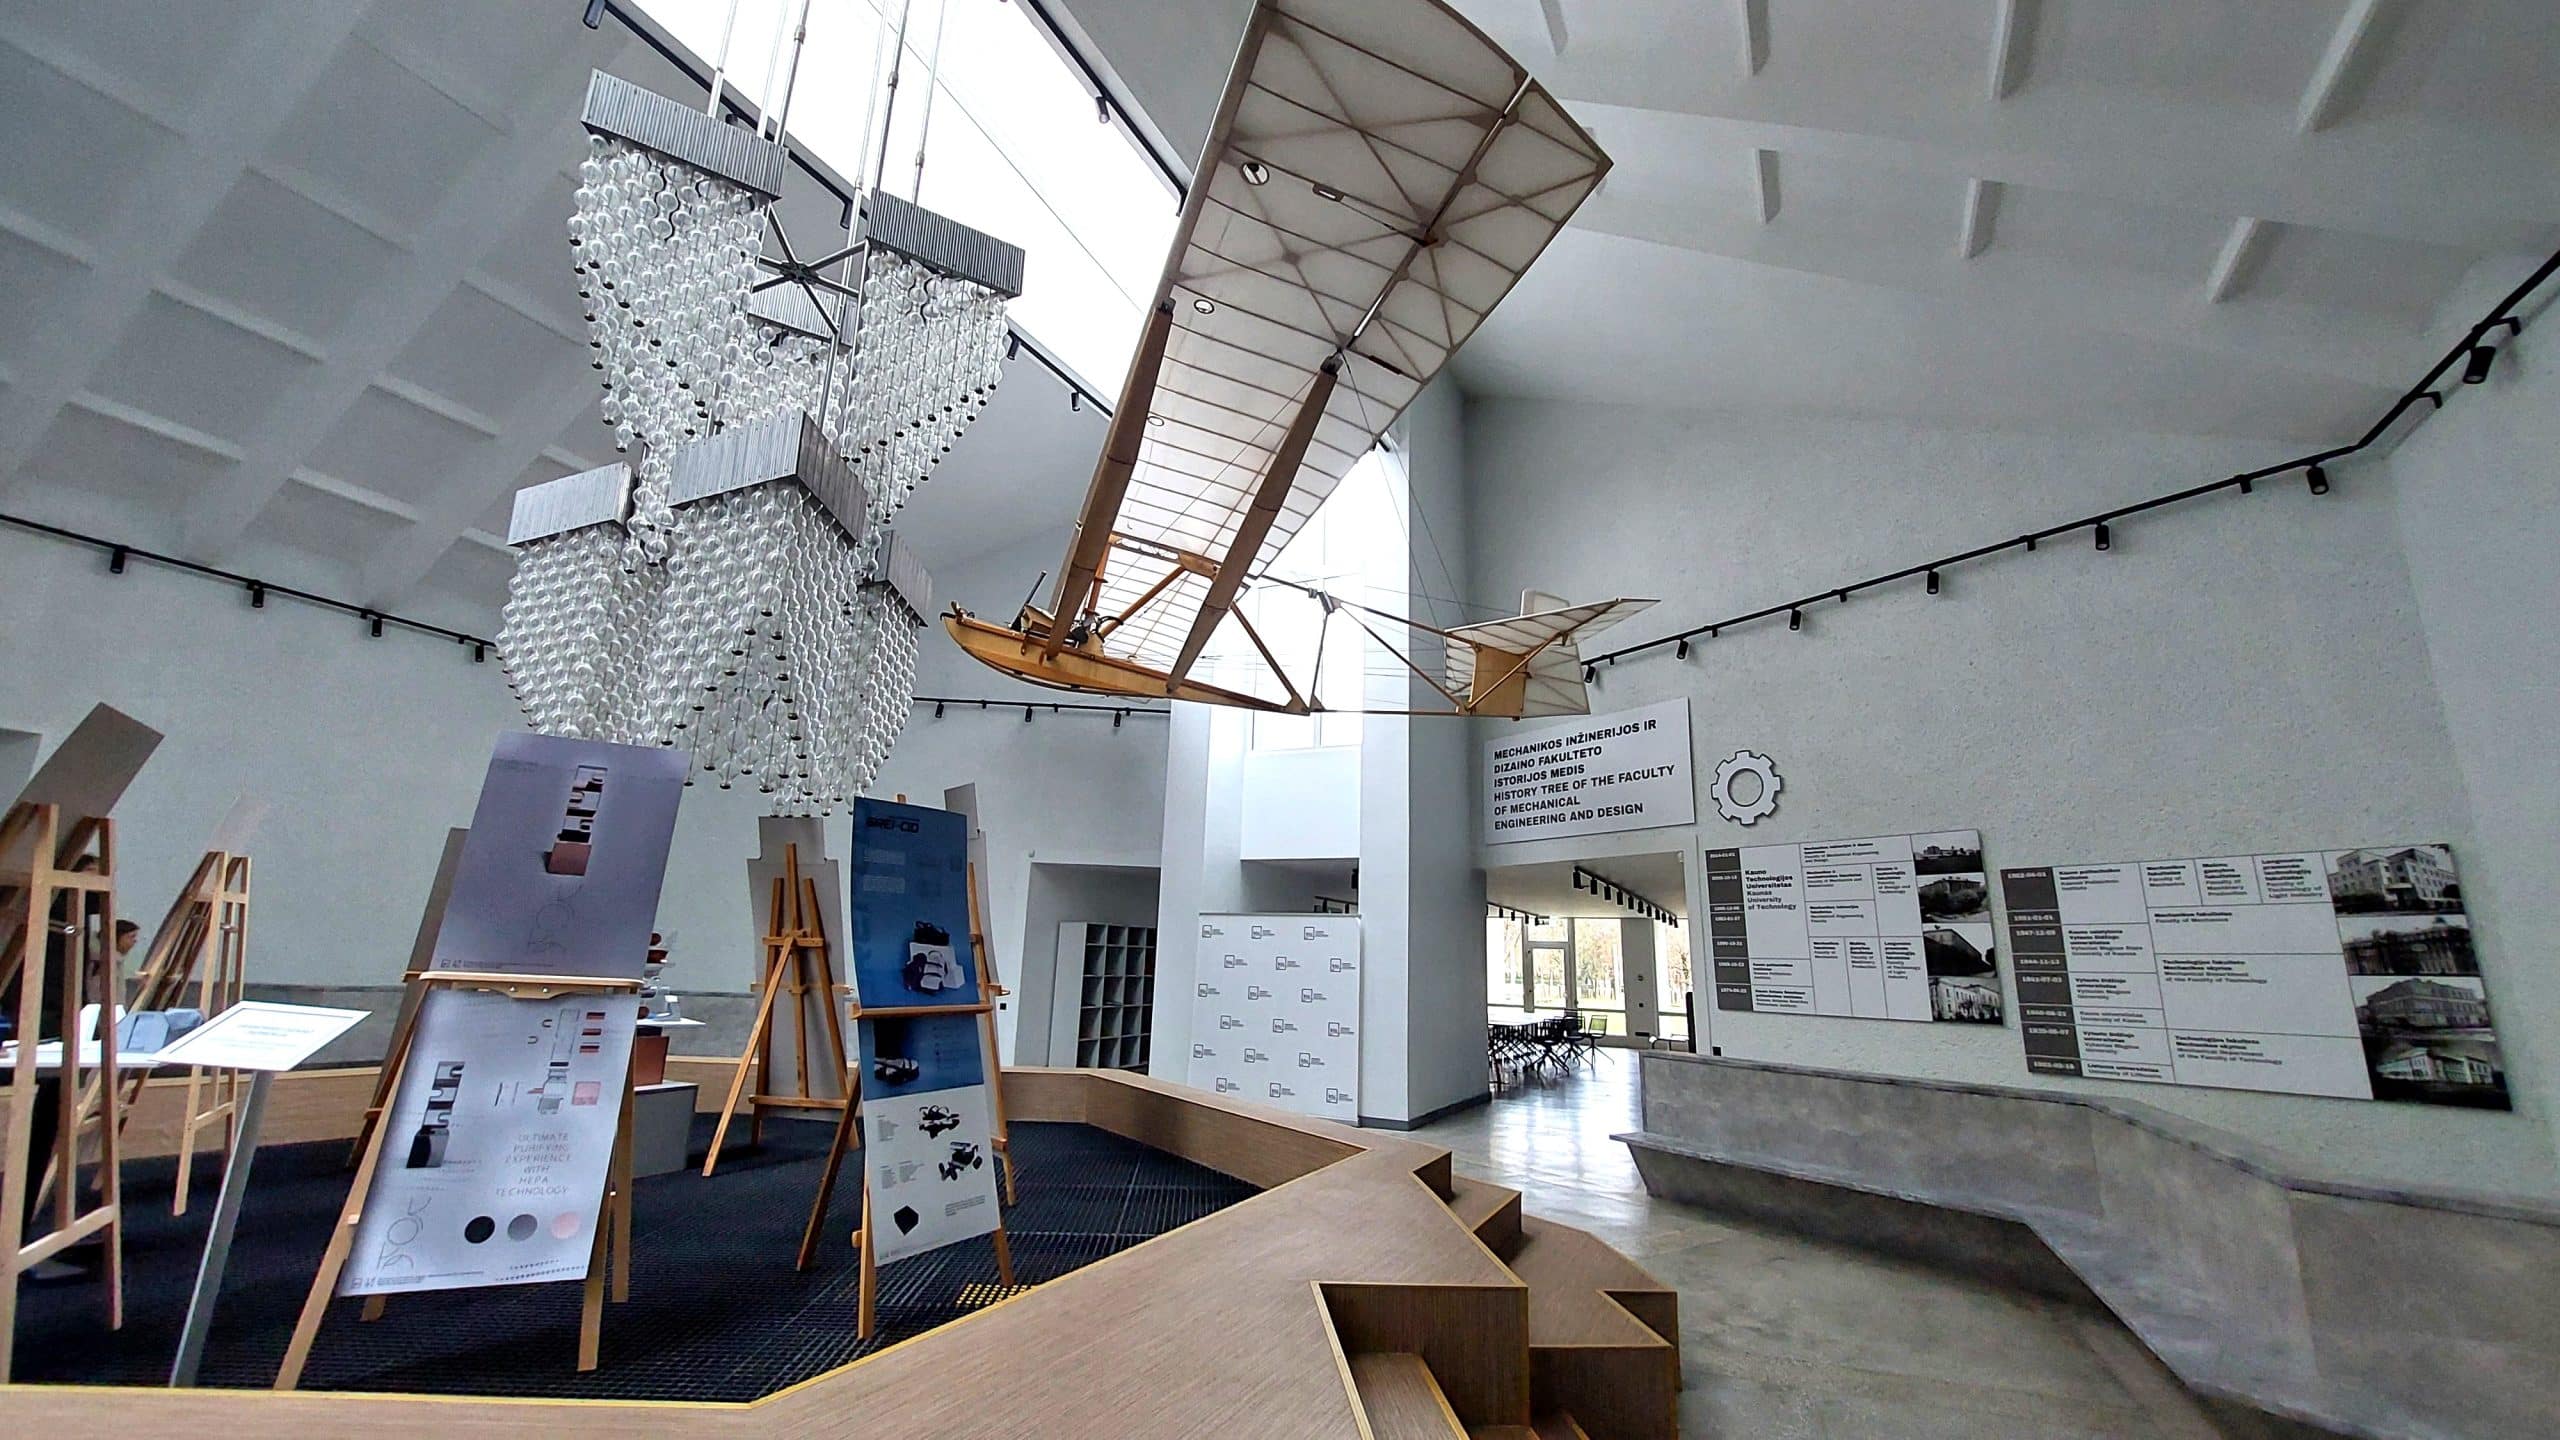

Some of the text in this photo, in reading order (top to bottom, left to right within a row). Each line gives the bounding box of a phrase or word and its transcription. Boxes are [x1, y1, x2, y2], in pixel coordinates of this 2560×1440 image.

[1494, 719, 1657, 760] MECHANIKOS INŽINERIJOS IR
[1494, 746, 1602, 774] DIZAINO FAKULTETO
[1494, 764, 1585, 787] ISTORIJOS MEDIS
[1494, 765, 1675, 802] HISTORY TREE OF THE FACULTY
[1494, 796, 1580, 816] OF MECHANICAL
[1495, 803, 1644, 830] ENGINEERING AND DESIGN
[496, 1185, 568, 1197] TECHNOLOGY
